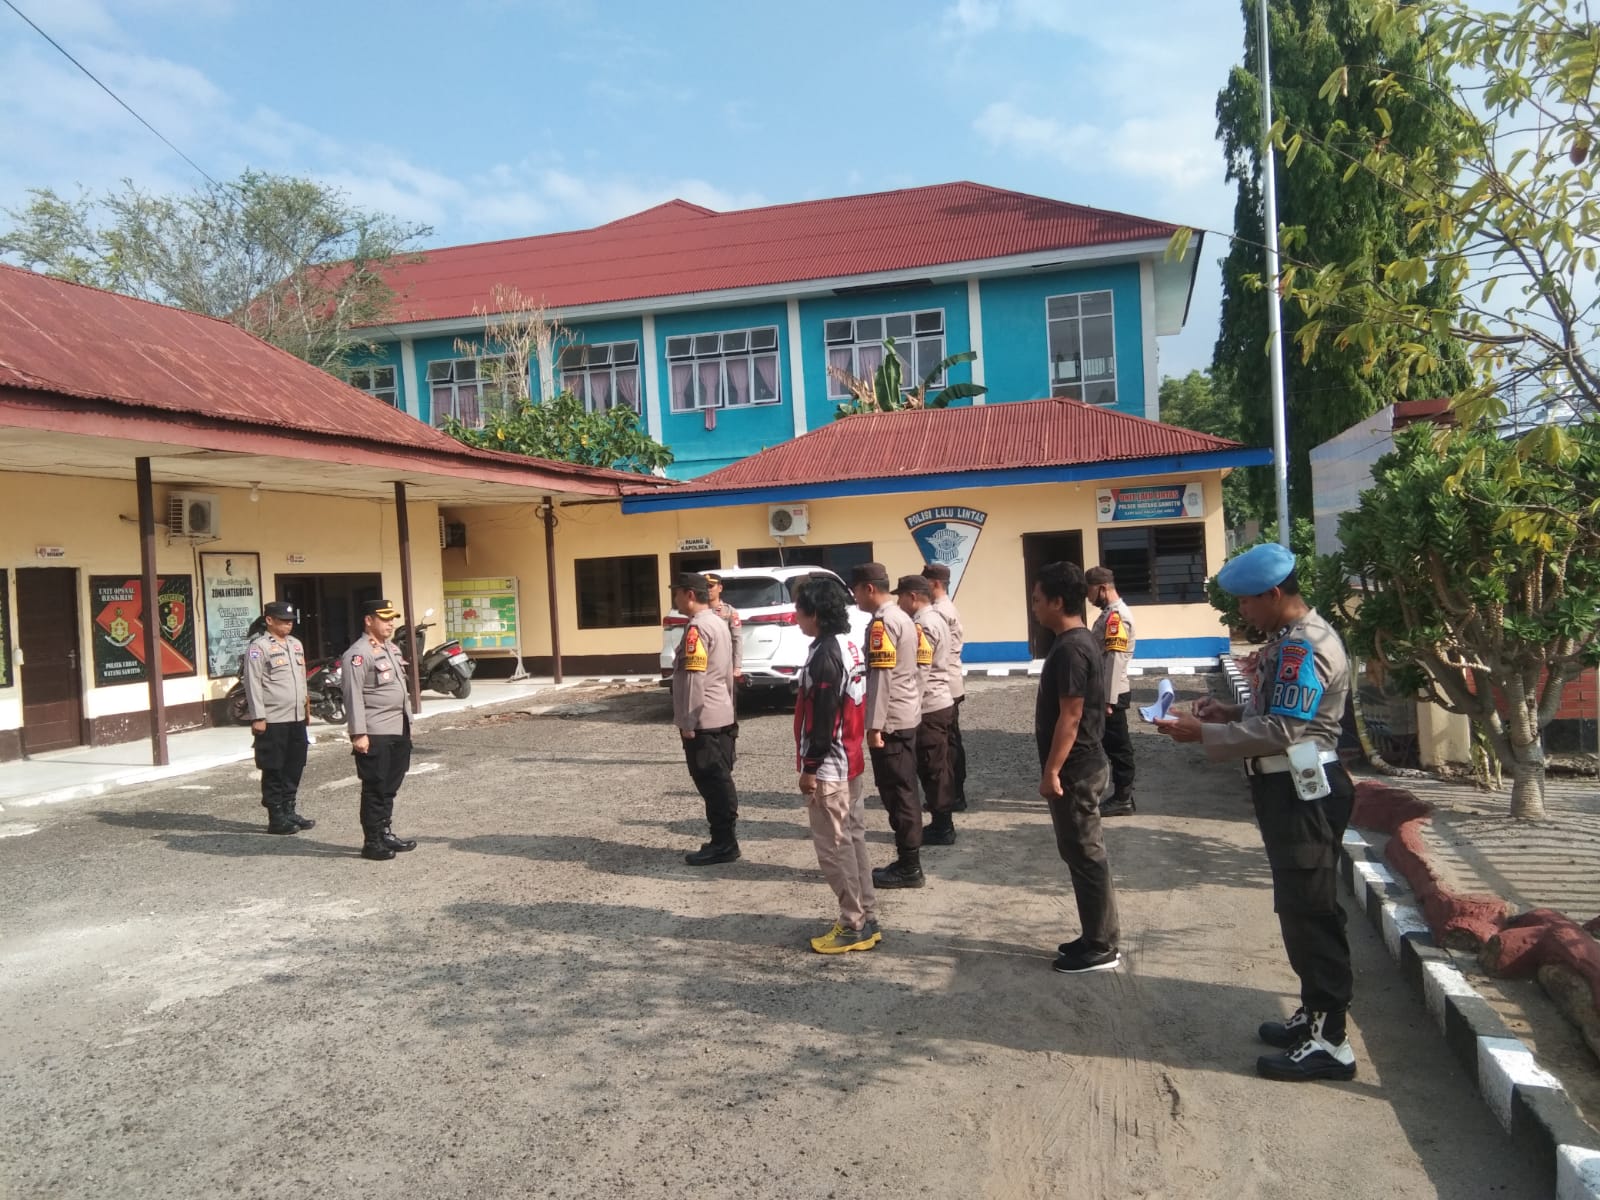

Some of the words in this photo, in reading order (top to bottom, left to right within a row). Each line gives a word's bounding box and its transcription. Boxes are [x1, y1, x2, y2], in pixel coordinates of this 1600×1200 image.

[907, 510, 933, 527] POLISI
[935, 507, 954, 518] LALU
[957, 507, 985, 522] LINTAS
[101, 594, 134, 602] RESKRIM
[211, 588, 225, 598] ZONA
[225, 587, 253, 597] INTEGRITAS
